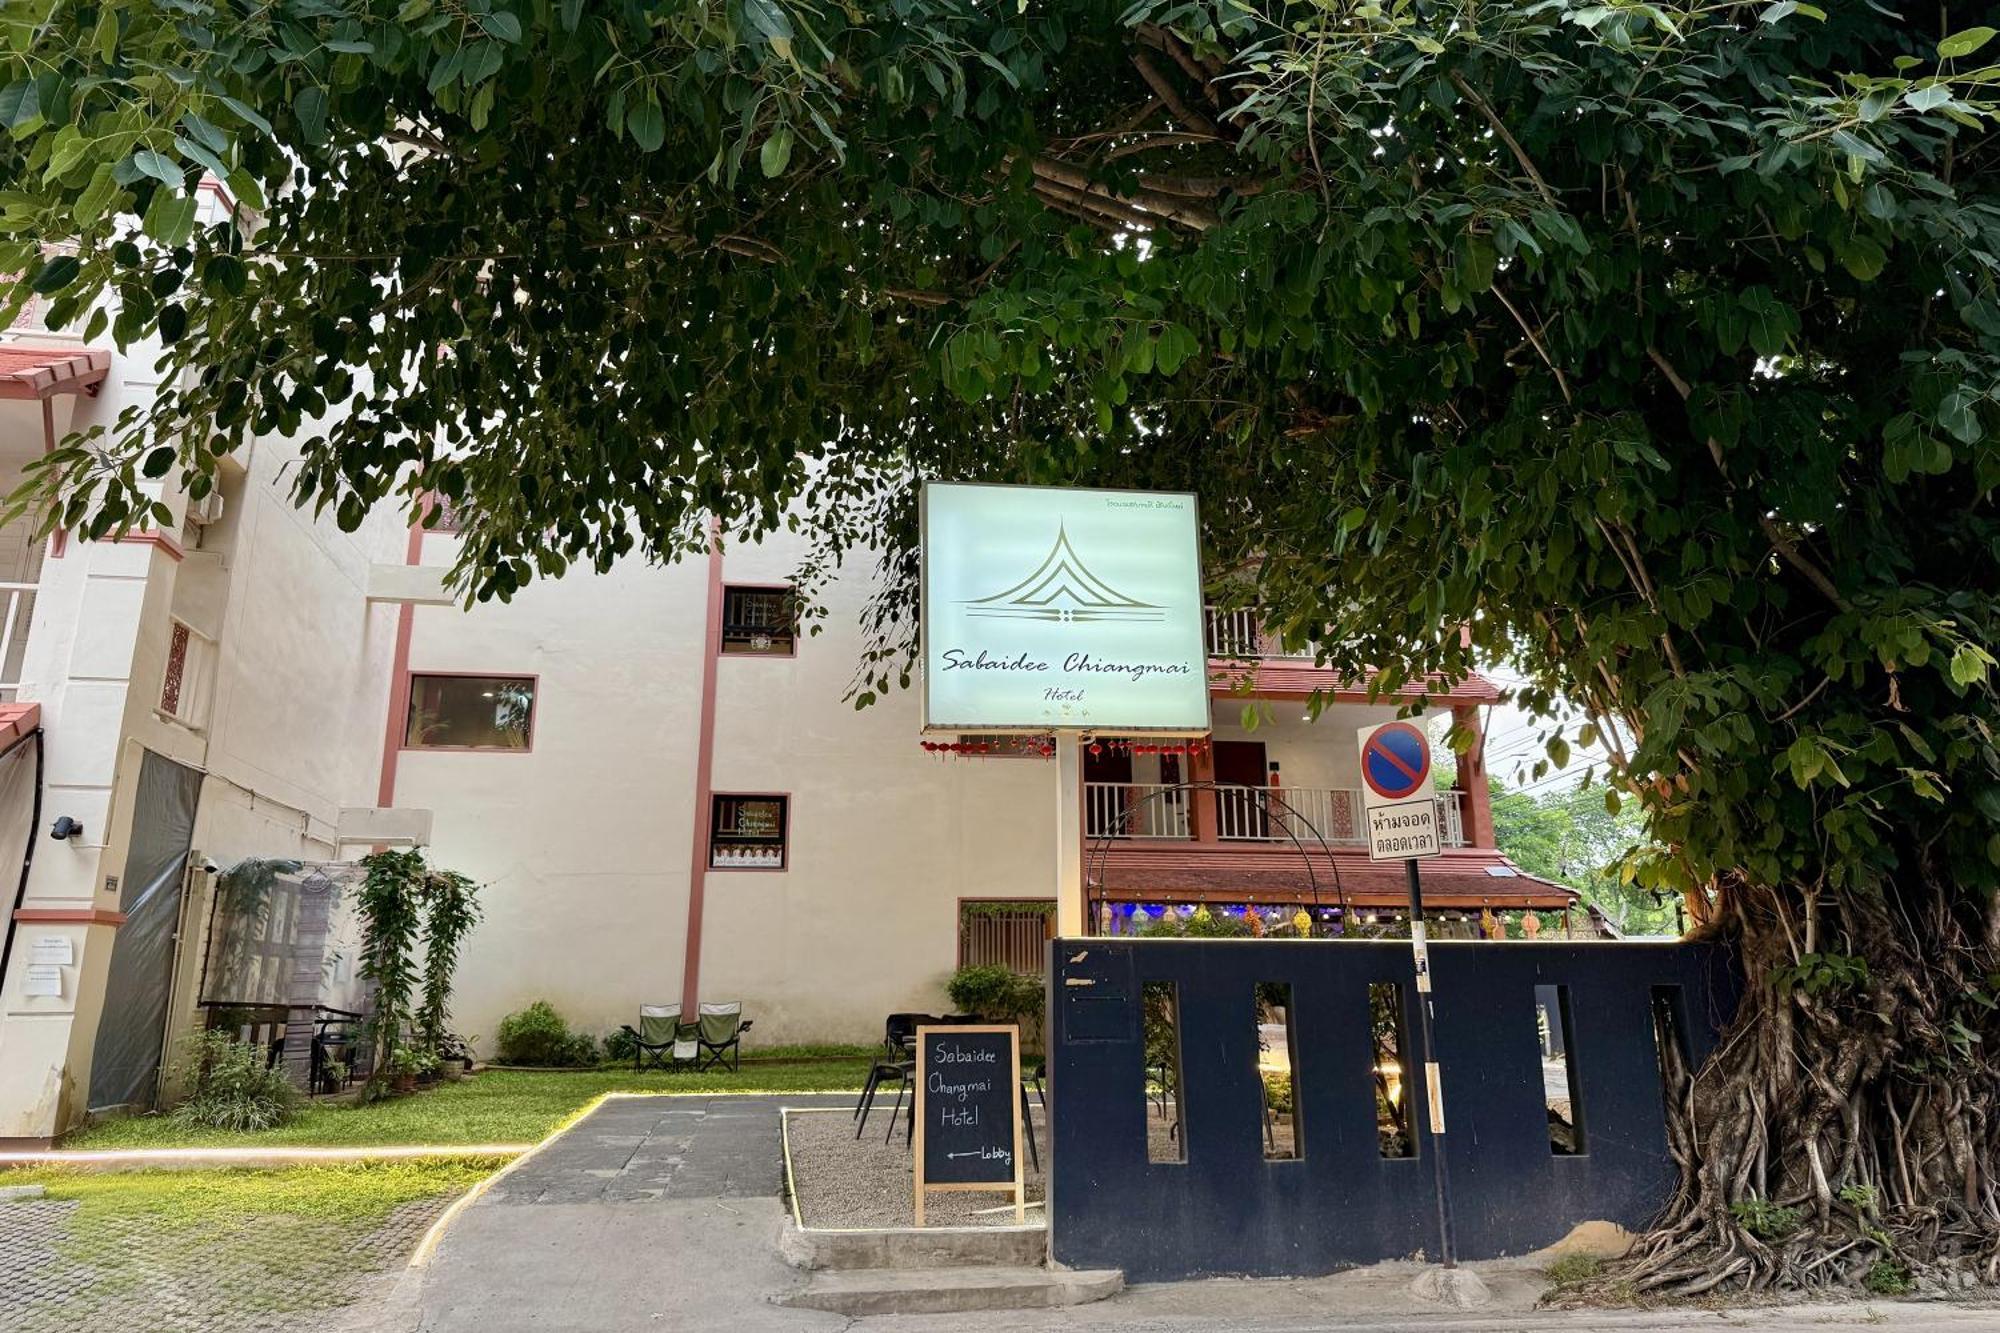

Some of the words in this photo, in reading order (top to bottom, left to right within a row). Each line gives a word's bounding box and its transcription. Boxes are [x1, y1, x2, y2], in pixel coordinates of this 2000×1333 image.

[942, 648, 1050, 672] Sabaidee
[1063, 652, 1190, 681] Chiangmai
[1044, 687, 1084, 701] Hotel
[1373, 811, 1431, 831] ห้ามจอด
[1376, 834, 1433, 853] ตลอดเวลา
[934, 1040, 996, 1063] Sabaidee
[941, 1104, 979, 1126] Hotel
[981, 1145, 1011, 1165] Lobby
